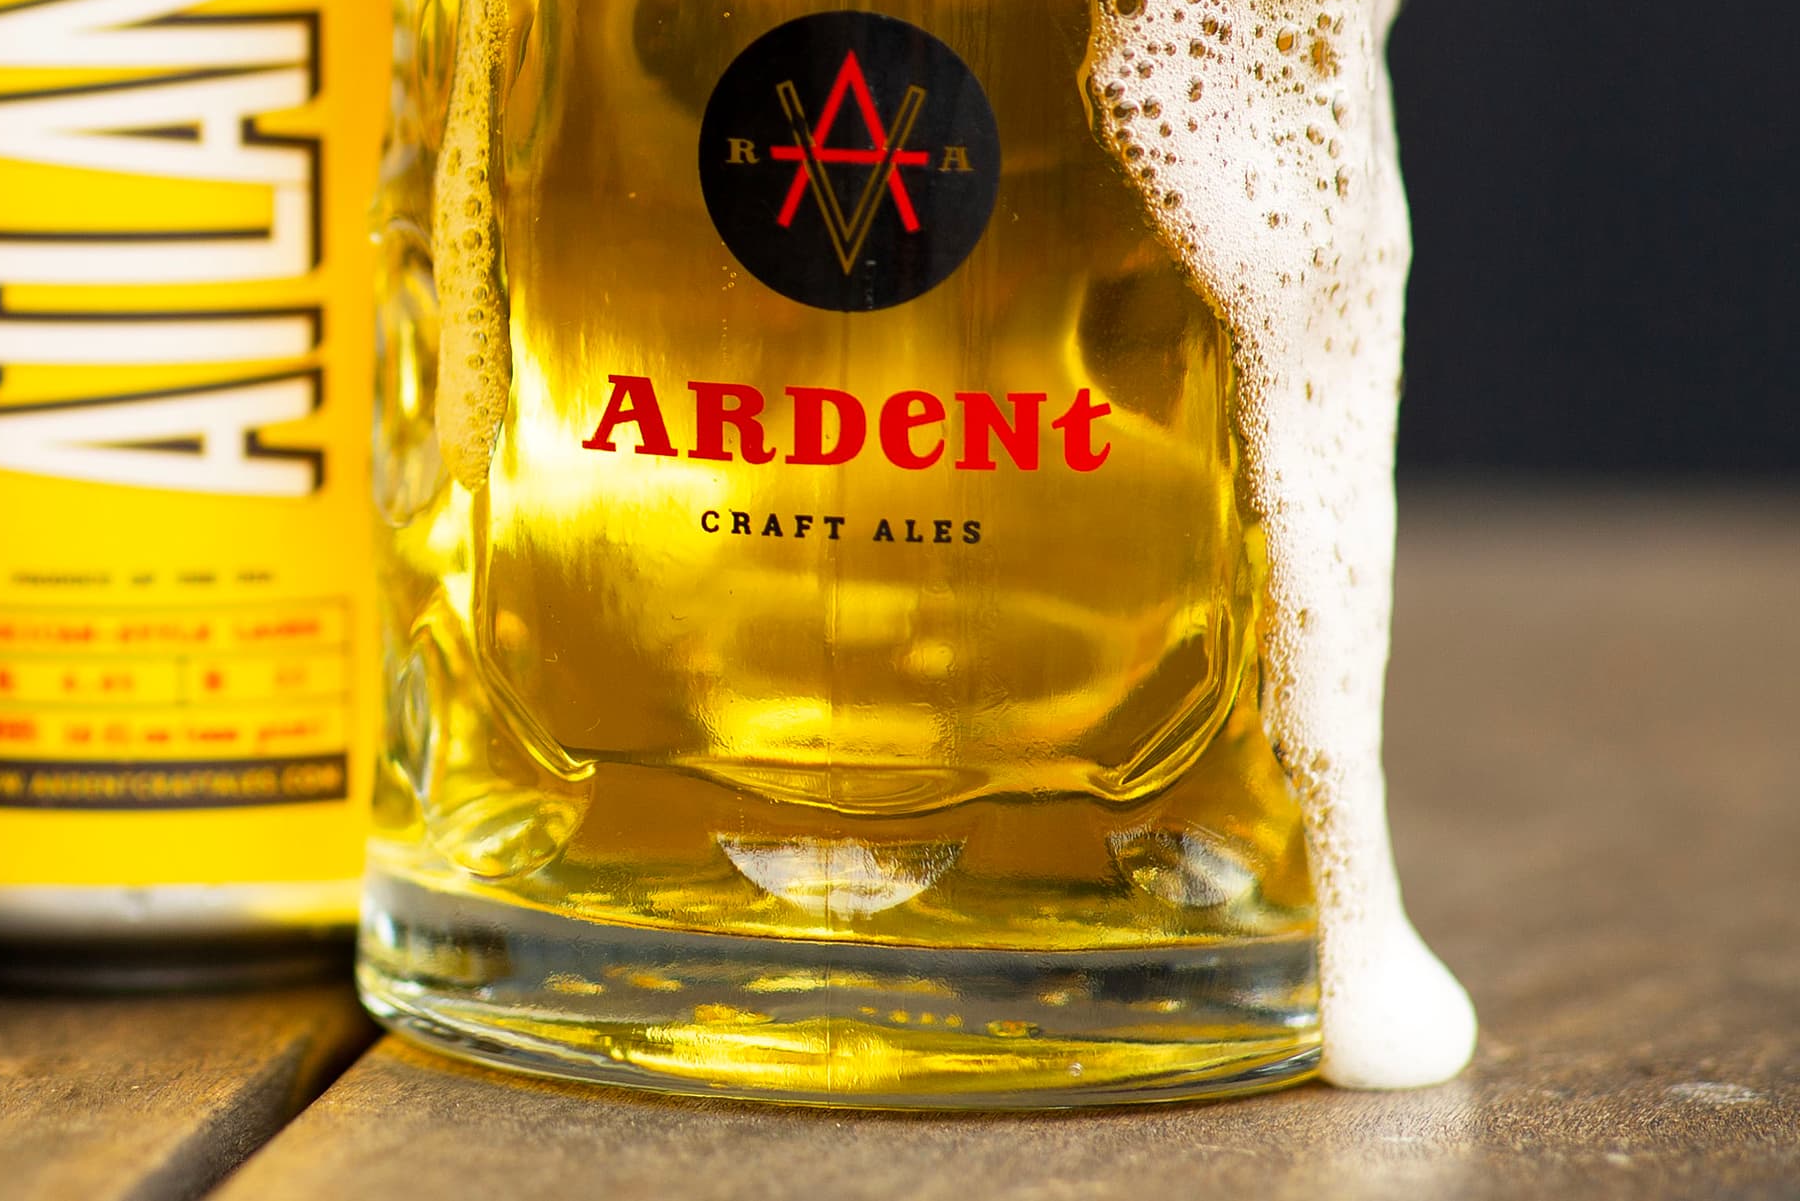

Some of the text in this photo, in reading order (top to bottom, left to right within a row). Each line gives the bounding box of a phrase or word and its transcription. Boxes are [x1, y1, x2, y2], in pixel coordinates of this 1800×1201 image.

[725, 136, 760, 165] R
[938, 145, 974, 172] A
[700, 509, 983, 545] CRAFT ALES
